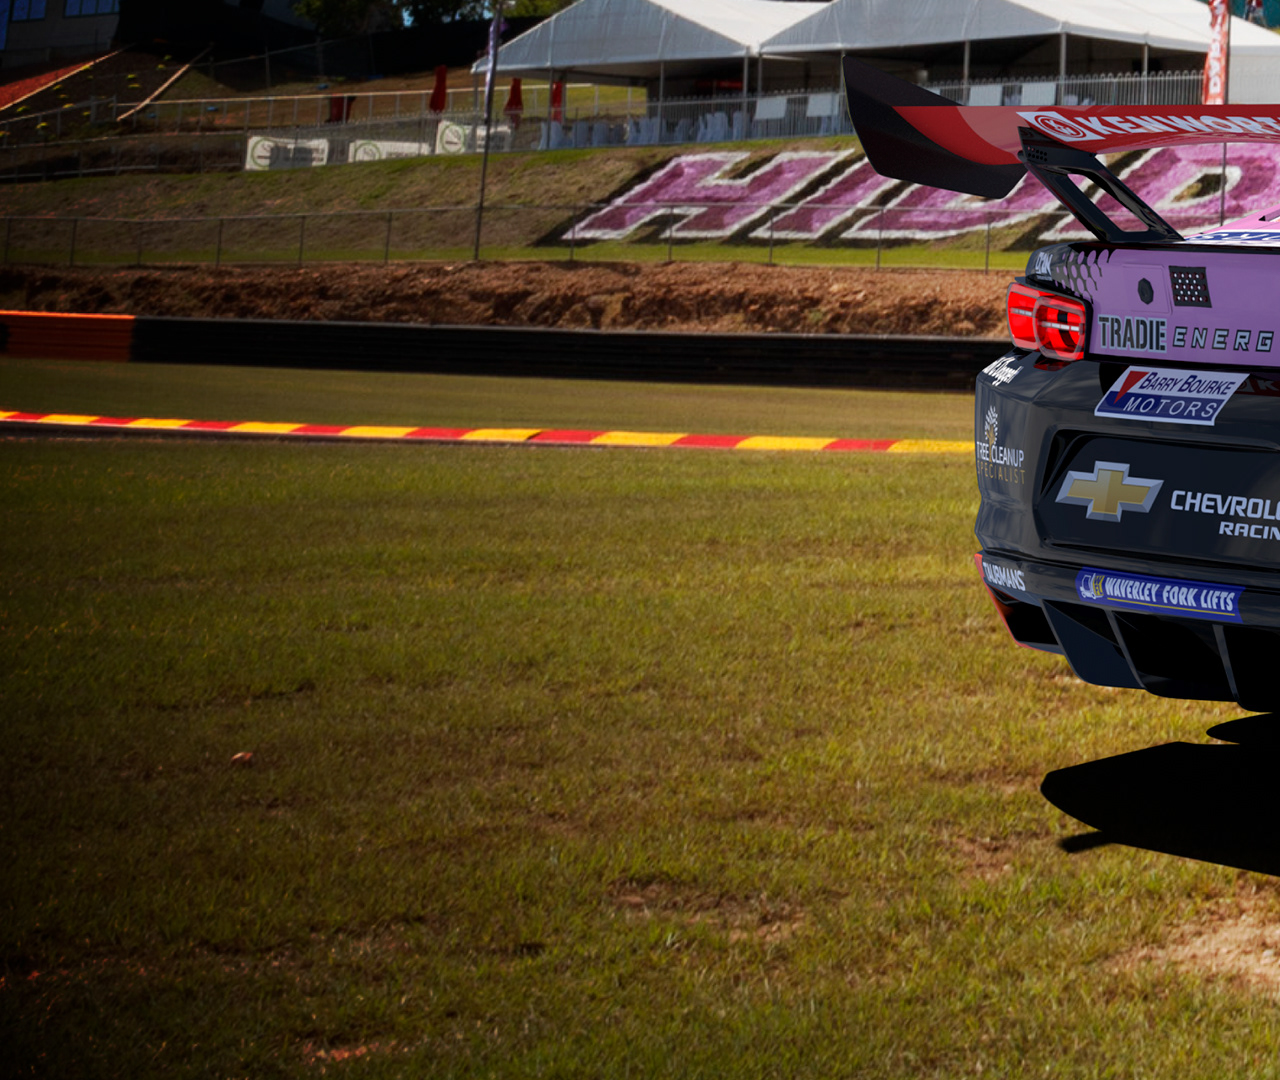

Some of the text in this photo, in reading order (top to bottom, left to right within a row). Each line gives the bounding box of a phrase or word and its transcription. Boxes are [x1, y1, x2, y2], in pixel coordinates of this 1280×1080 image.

[1098, 315, 1167, 353] TRADIE
[1138, 371, 1236, 396] BARRY BOURKE
[1123, 396, 1217, 418] MOTORS
[991, 445, 1024, 467] CLEANUP
[977, 460, 1025, 484] SPECIALIST
[1105, 576, 1235, 612] WAVERLEY FORK LIFTS
